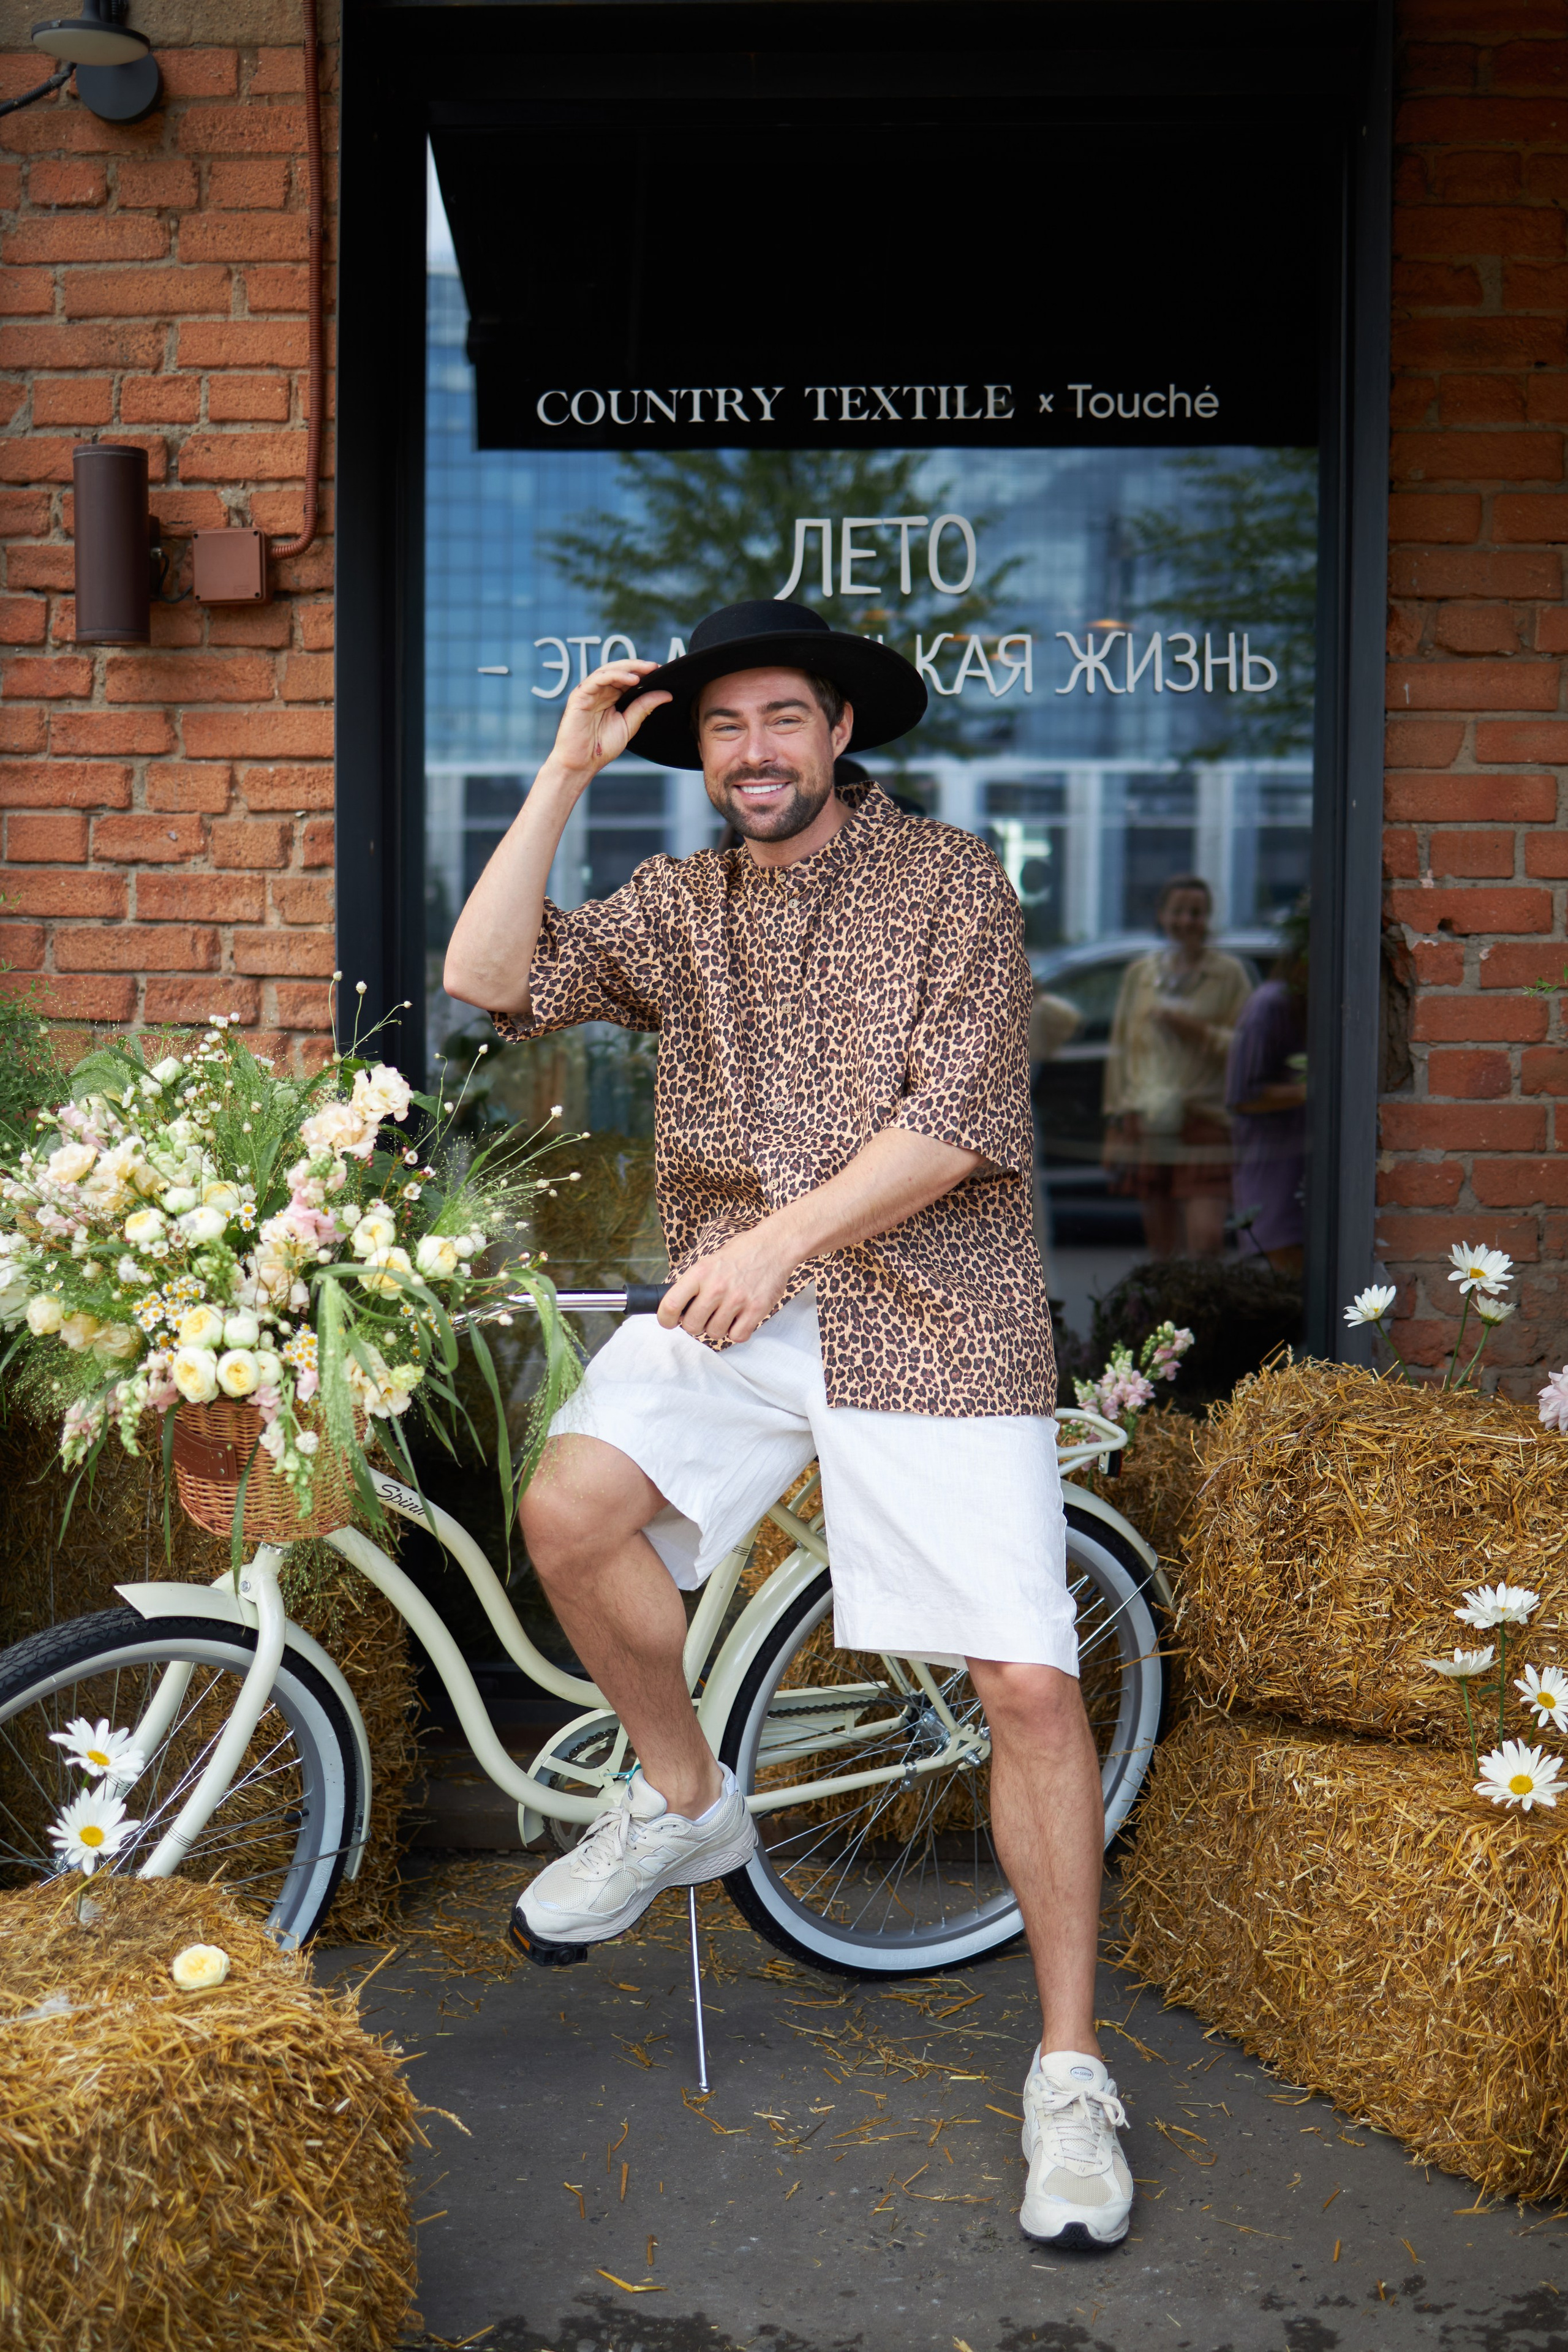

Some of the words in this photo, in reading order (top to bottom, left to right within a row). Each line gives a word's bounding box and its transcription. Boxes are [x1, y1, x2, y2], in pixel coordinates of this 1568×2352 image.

[537, 387, 785, 426] COUNTRY
[804, 385, 1016, 421] TEXTILE
[1068, 384, 1219, 418] Touché
[774, 514, 977, 600] ЛЕТО
[1055, 631, 1278, 694] ЖИЗНЬ
